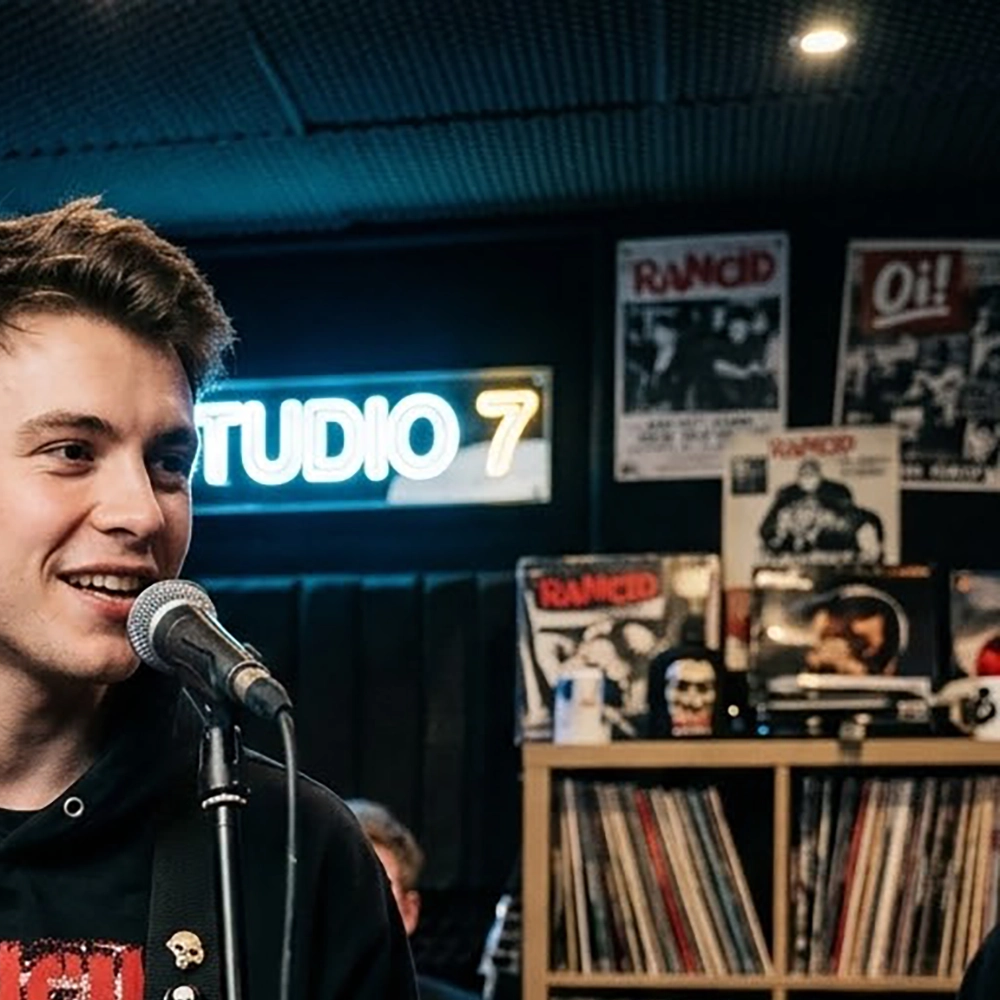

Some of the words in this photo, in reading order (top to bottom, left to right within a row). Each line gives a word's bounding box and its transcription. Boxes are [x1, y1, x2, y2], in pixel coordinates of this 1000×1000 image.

[633, 251, 776, 295] RANCID
[872, 254, 952, 315] Oi!
[193, 391, 460, 487] TUDIO
[475, 388, 541, 478] 7
